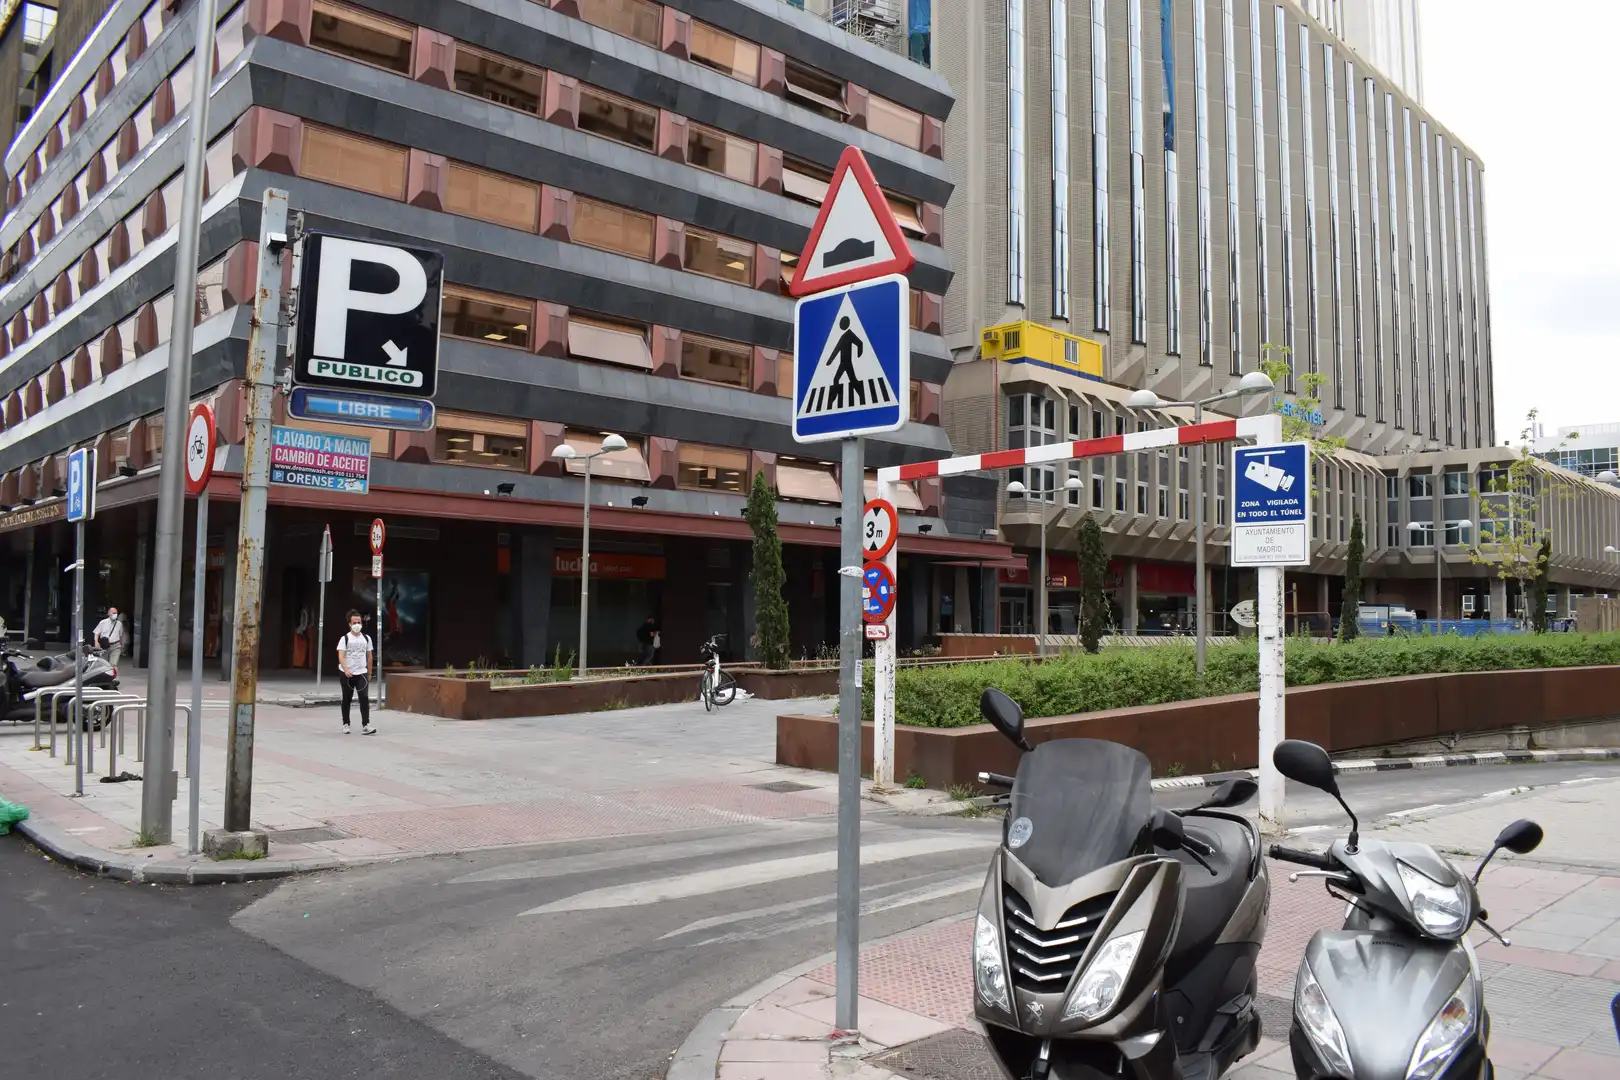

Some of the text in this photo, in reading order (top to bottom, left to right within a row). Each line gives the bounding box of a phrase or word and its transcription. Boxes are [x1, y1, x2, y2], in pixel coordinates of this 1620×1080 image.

[313, 236, 428, 359] P
[317, 361, 415, 384] PUBLICO
[338, 400, 392, 418] LIBRE
[276, 430, 368, 456] LAVADO A MANO
[275, 448, 366, 472] CAMBIO DE ACEITE
[71, 460, 80, 513] P
[286, 472, 334, 488] ORENSE
[1280, 507, 1303, 516] TÚNEL
[1245, 527, 1295, 536] AYUNTAMIENTO
[1256, 545, 1282, 553] MADRID
